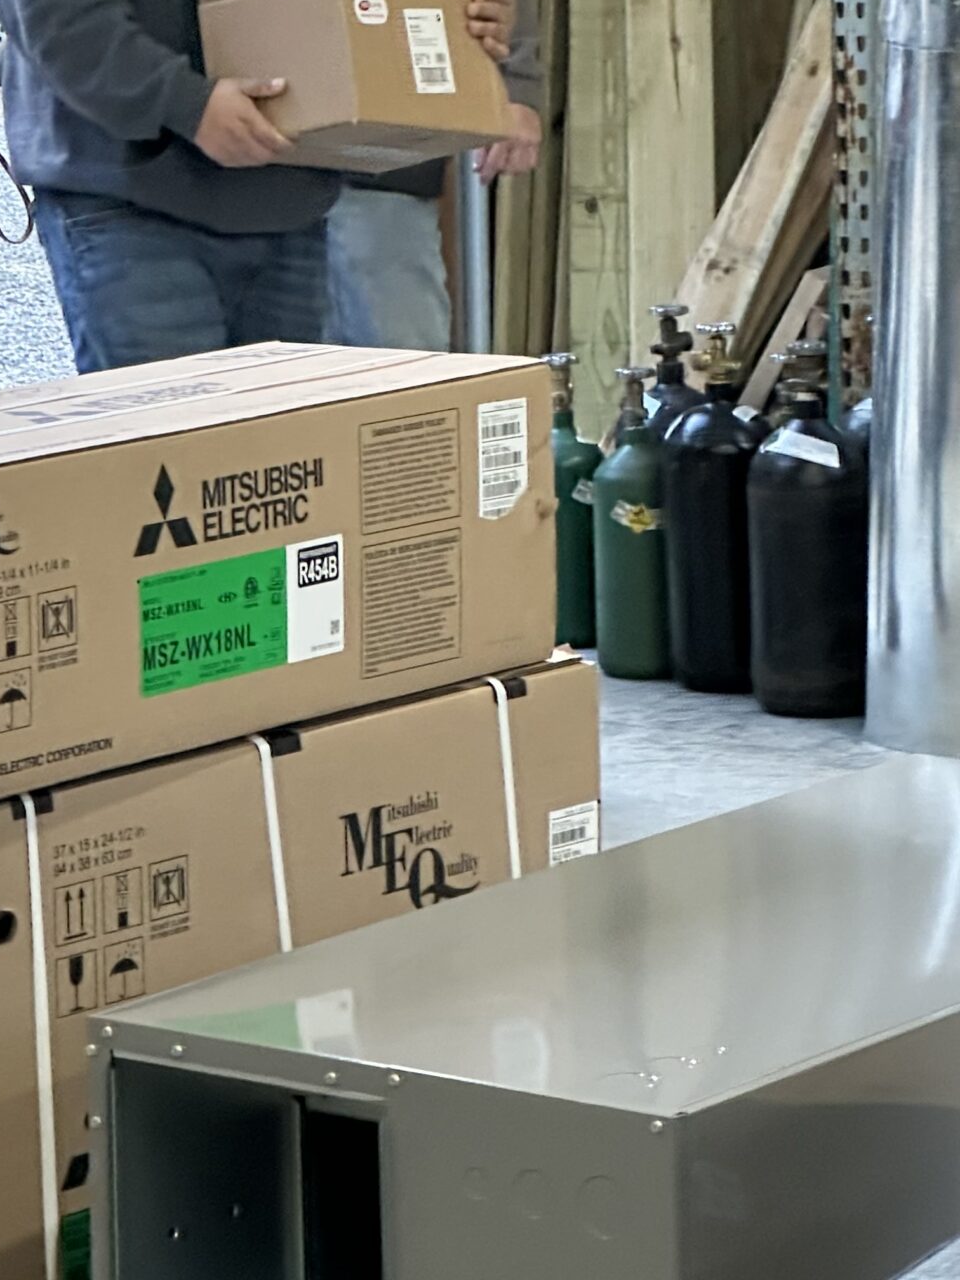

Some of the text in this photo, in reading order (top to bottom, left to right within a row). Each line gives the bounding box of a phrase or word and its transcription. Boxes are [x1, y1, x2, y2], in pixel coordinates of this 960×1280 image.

[202, 457, 323, 508] MITSUBISHI
[203, 494, 308, 542] ELECTRIC
[299, 556, 337, 585] R454B
[143, 624, 256, 671] MSZ-WX18NL
[0, 754, 44, 776] ELECTRIC
[46, 738, 113, 764] CORPORATION
